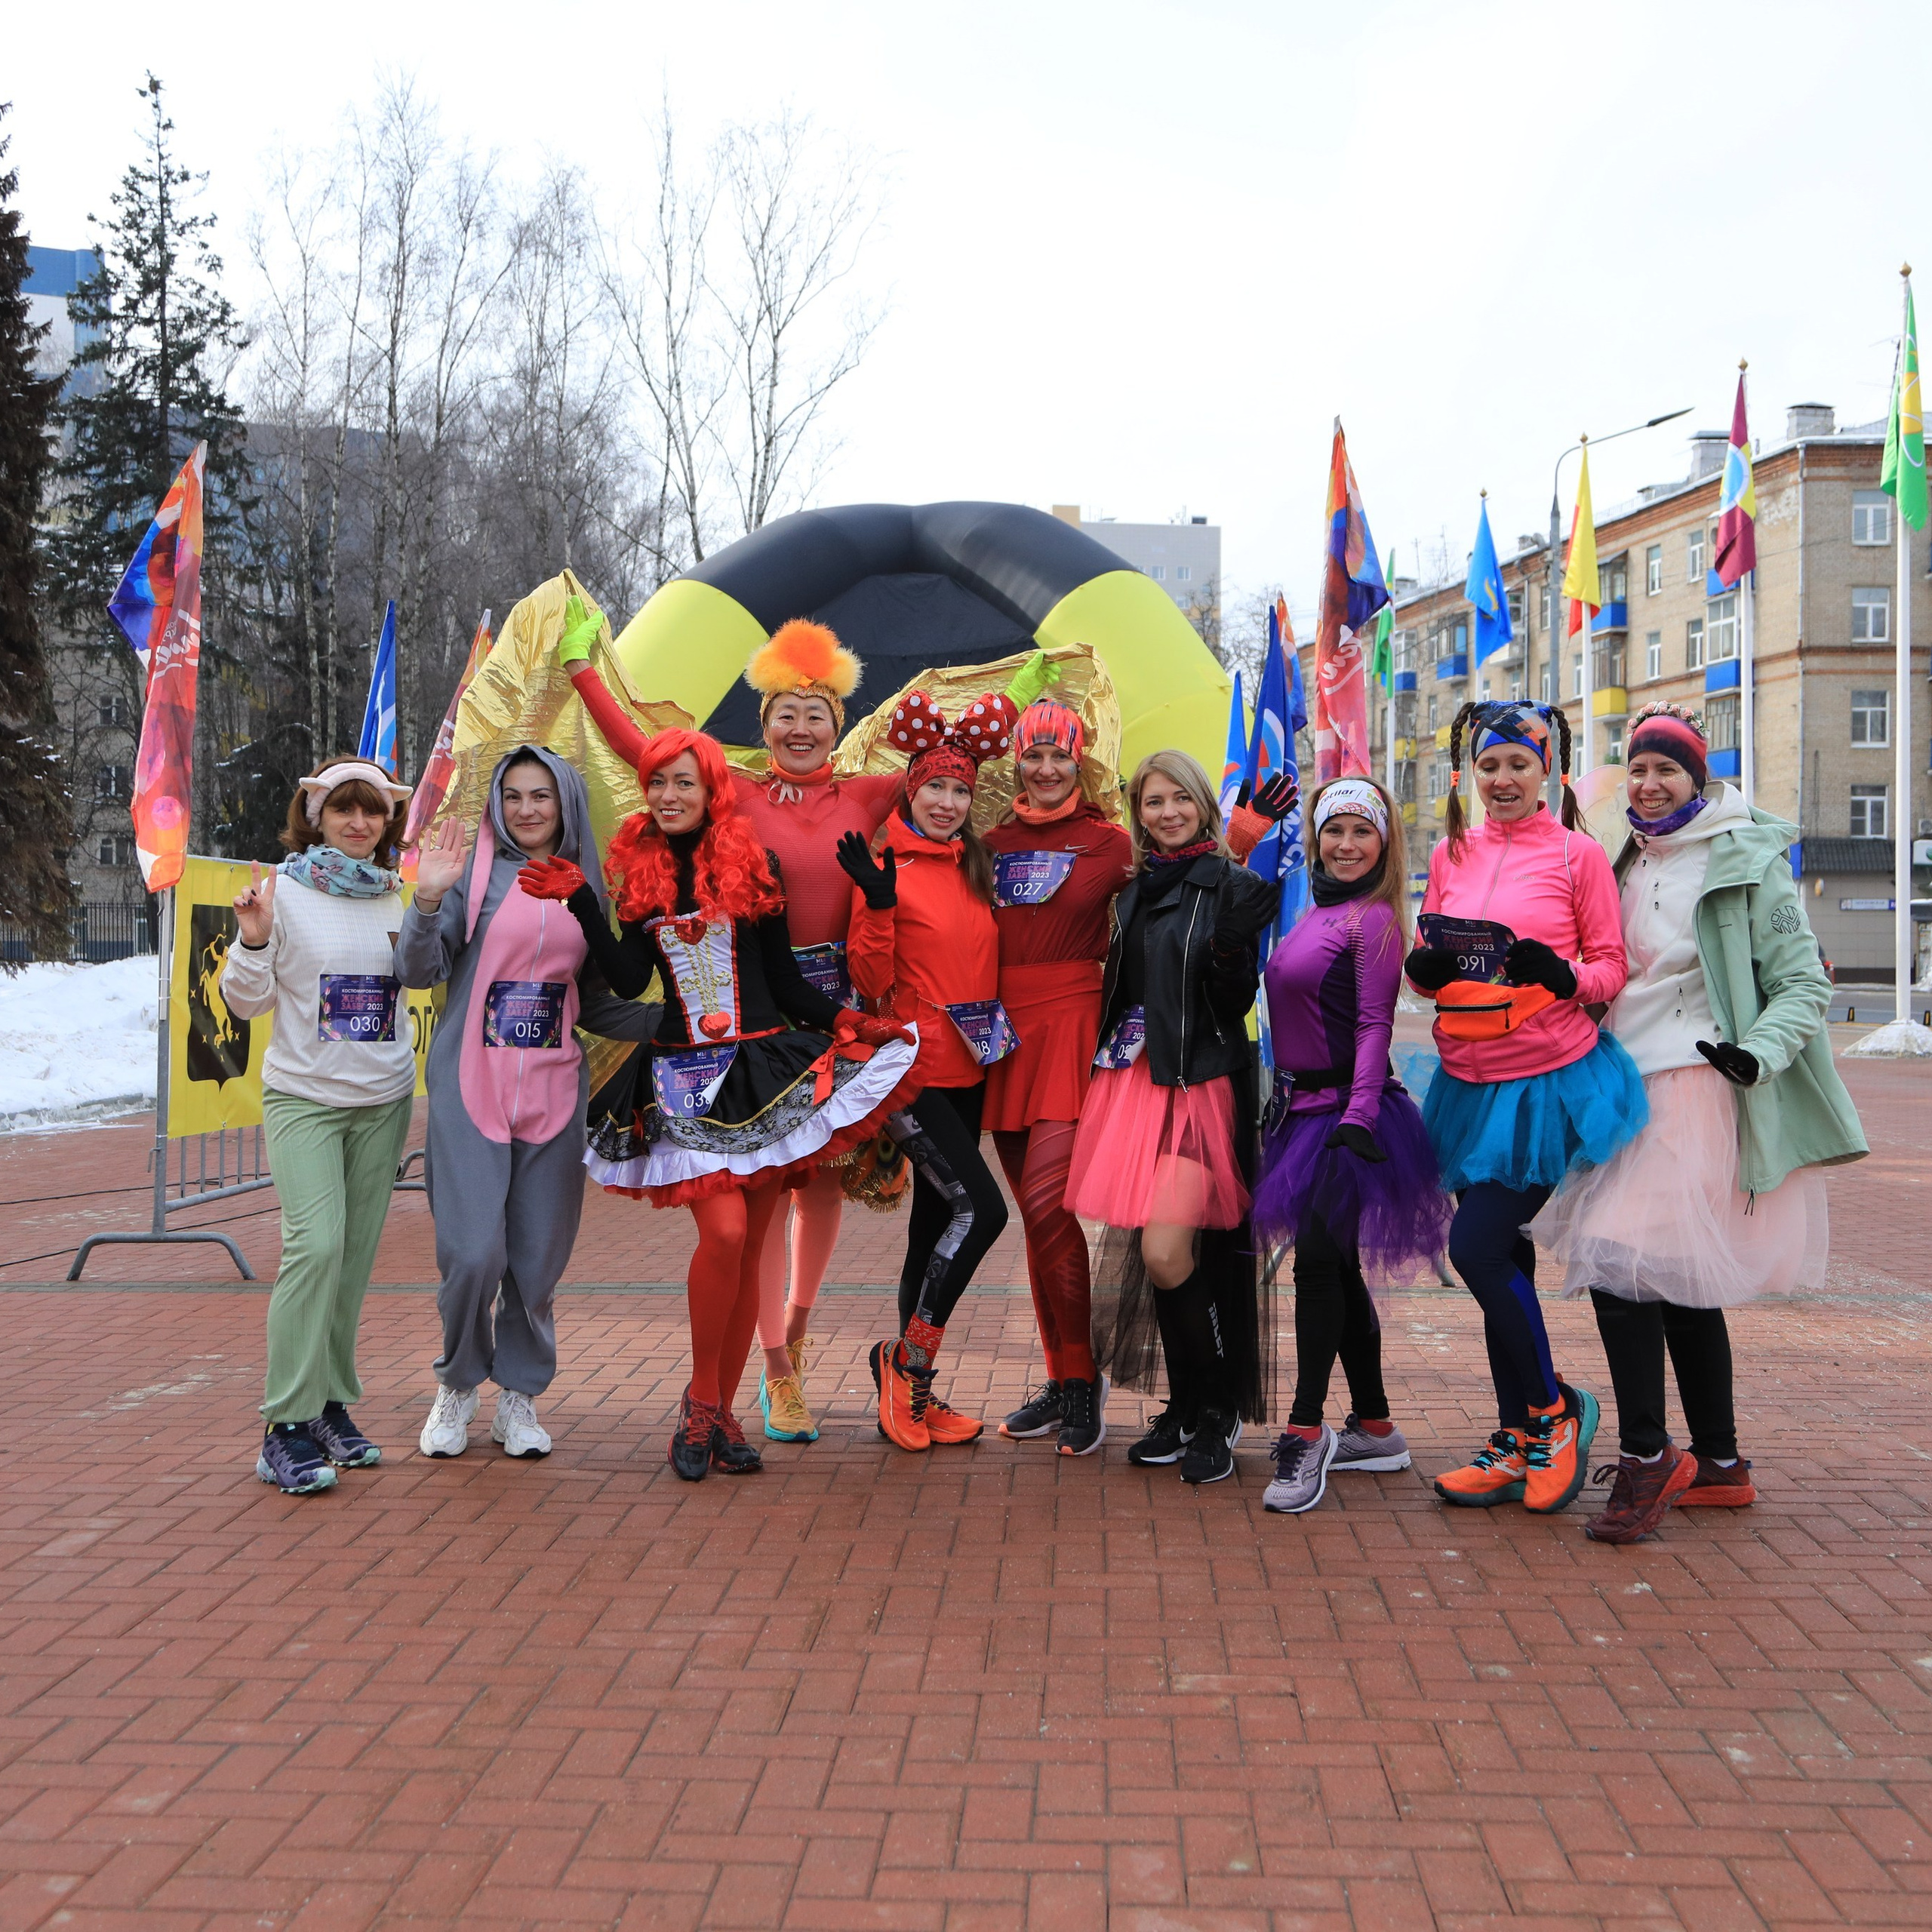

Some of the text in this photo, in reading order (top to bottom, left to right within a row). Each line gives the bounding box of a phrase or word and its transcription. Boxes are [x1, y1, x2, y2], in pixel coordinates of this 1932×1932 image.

[1013, 882, 1044, 897] 027
[1457, 955, 1485, 973] 091
[821, 981, 840, 991] 2023
[340, 994, 384, 1003] ЖЕНСКИЙ
[340, 1002, 365, 1011] ЗАБЕГ
[506, 1001, 549, 1009] ЖЕНСКИЙ
[533, 1009, 549, 1017] 2023
[349, 1016, 380, 1032] 030
[515, 1022, 541, 1038] 015
[978, 1026, 992, 1035] 2023
[972, 1040, 991, 1055] 18
[674, 1062, 718, 1073] КОСТЮМИРОВАННЫЙ
[674, 1068, 719, 1081] ЖЕНСКИЙ
[684, 1092, 709, 1109] 03
